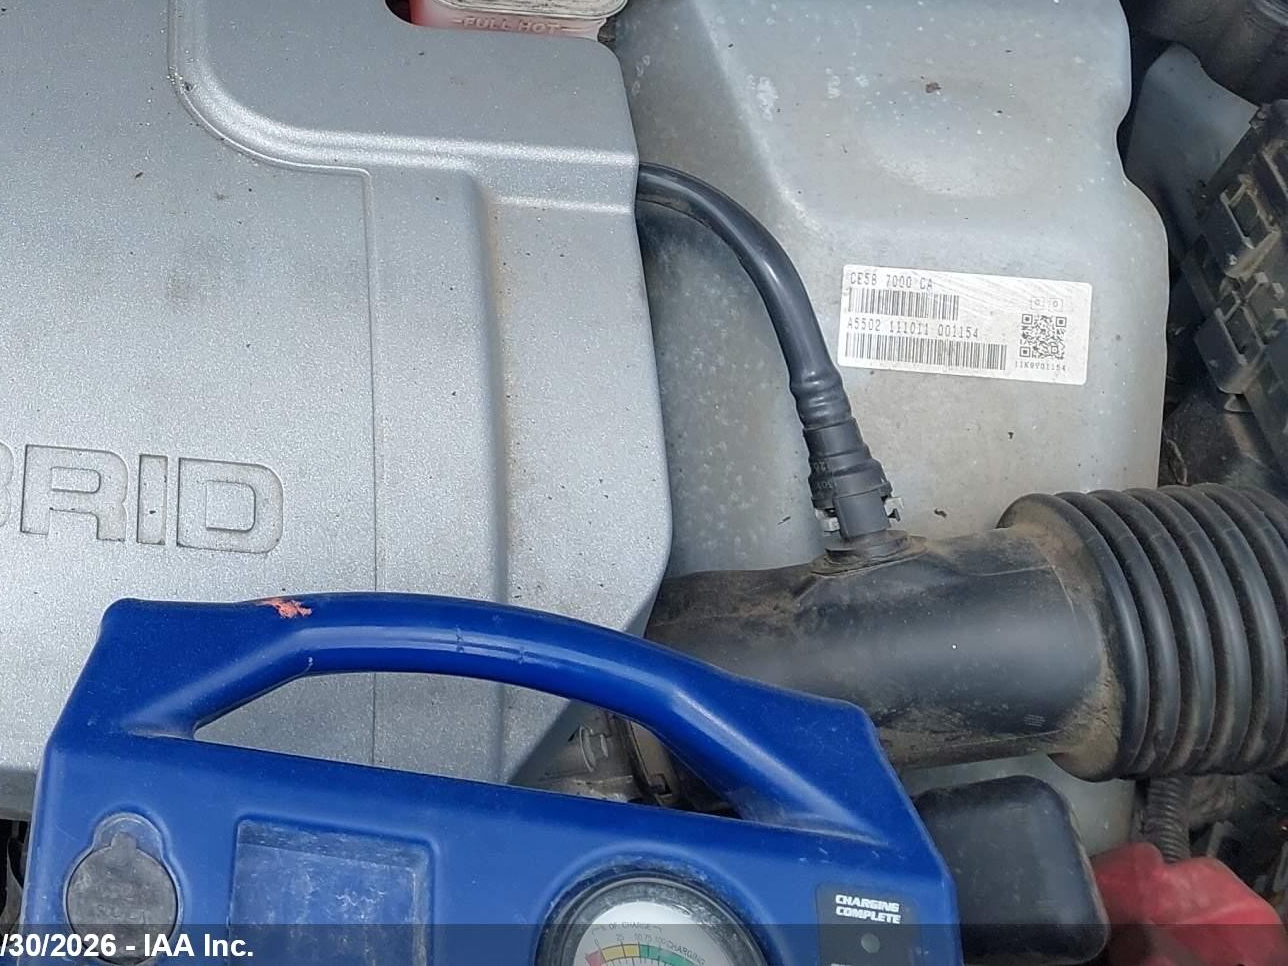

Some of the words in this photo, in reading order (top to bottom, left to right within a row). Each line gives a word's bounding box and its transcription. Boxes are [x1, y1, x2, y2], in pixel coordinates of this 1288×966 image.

[462, 17, 513, 31] FULL
[518, 19, 561, 34] HOT
[885, 273, 913, 289] 7000
[919, 277, 933, 291] CA
[847, 316, 882, 332] A5502
[889, 319, 930, 336] 111011
[937, 323, 979, 340] 001154
[835, 894, 900, 913] CHARGING
[835, 905, 902, 925] COMPLETE
